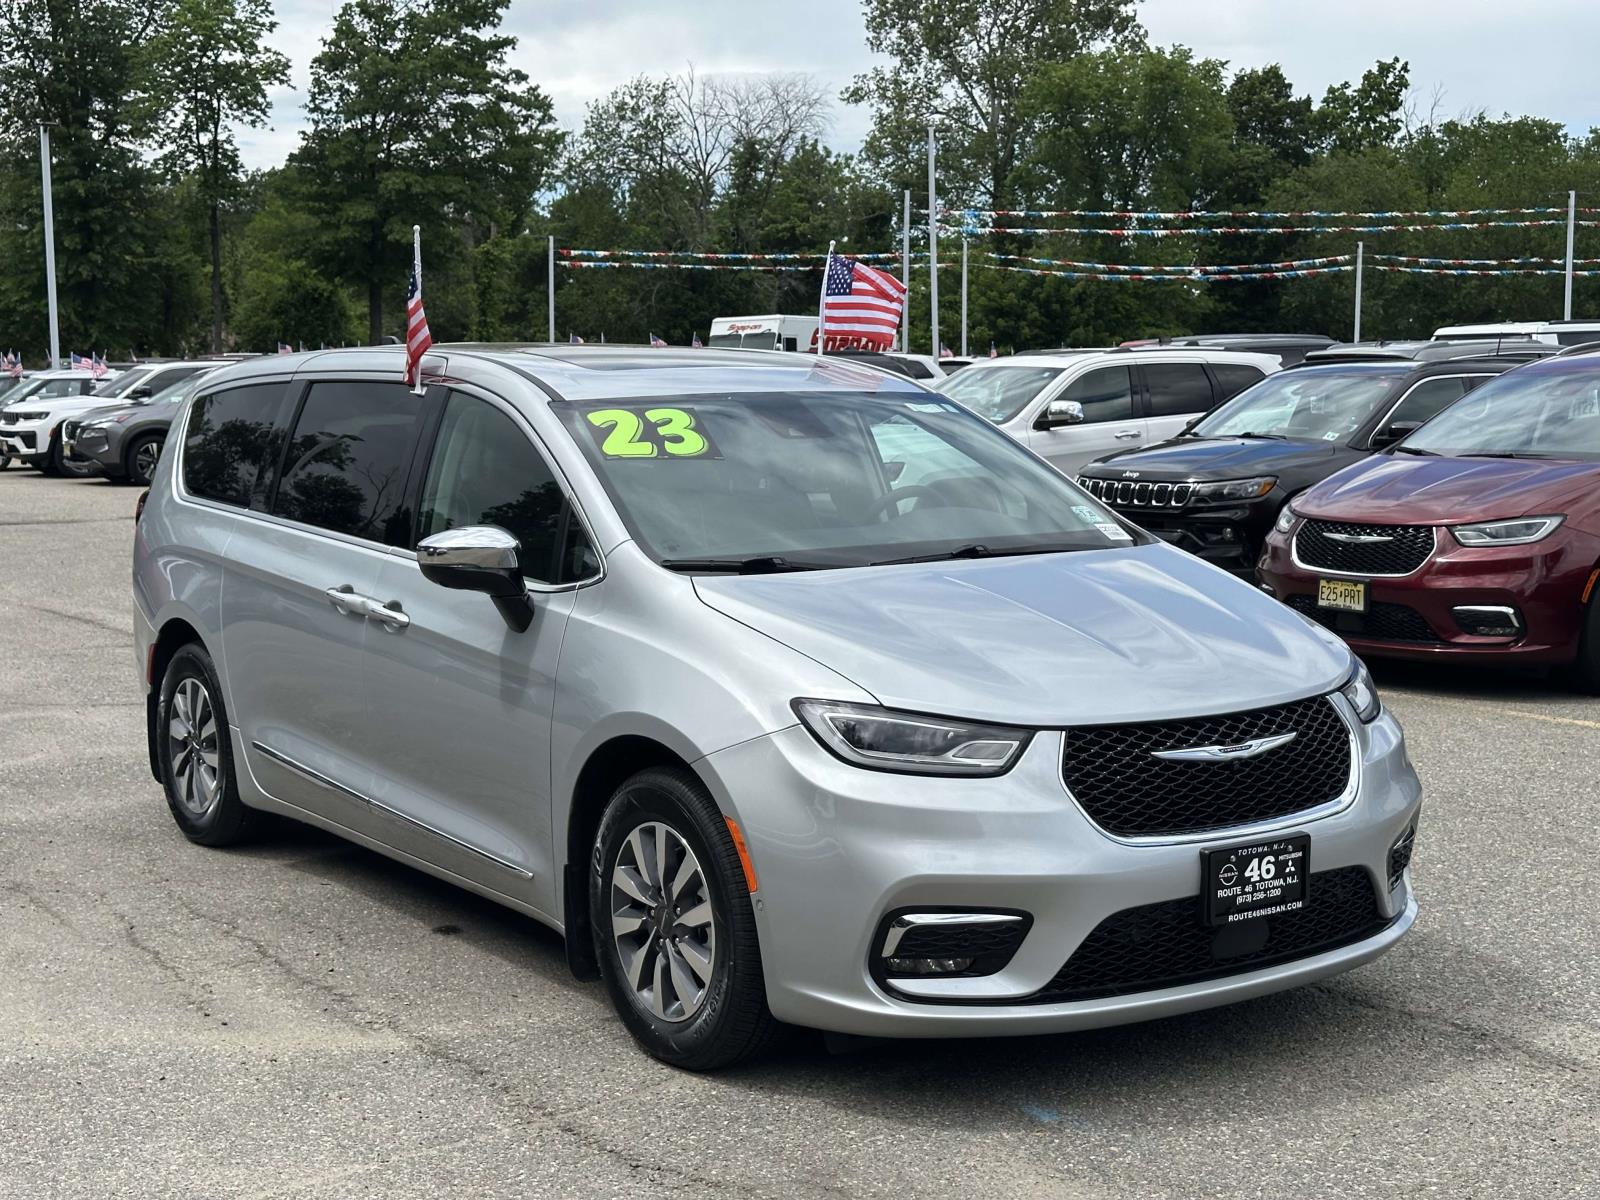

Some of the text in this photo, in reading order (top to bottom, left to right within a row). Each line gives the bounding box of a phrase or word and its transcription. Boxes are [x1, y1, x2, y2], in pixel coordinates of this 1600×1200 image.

[586, 408, 709, 457] 23
[1122, 470, 1140, 478] Jeep
[1244, 855, 1276, 882] 46
[1217, 875, 1299, 899] ROUTE 46 TOTOWA, N.J.
[1236, 887, 1282, 906] (973) 256-1200
[1228, 900, 1303, 923] ROUTE46NISSAN.COM
